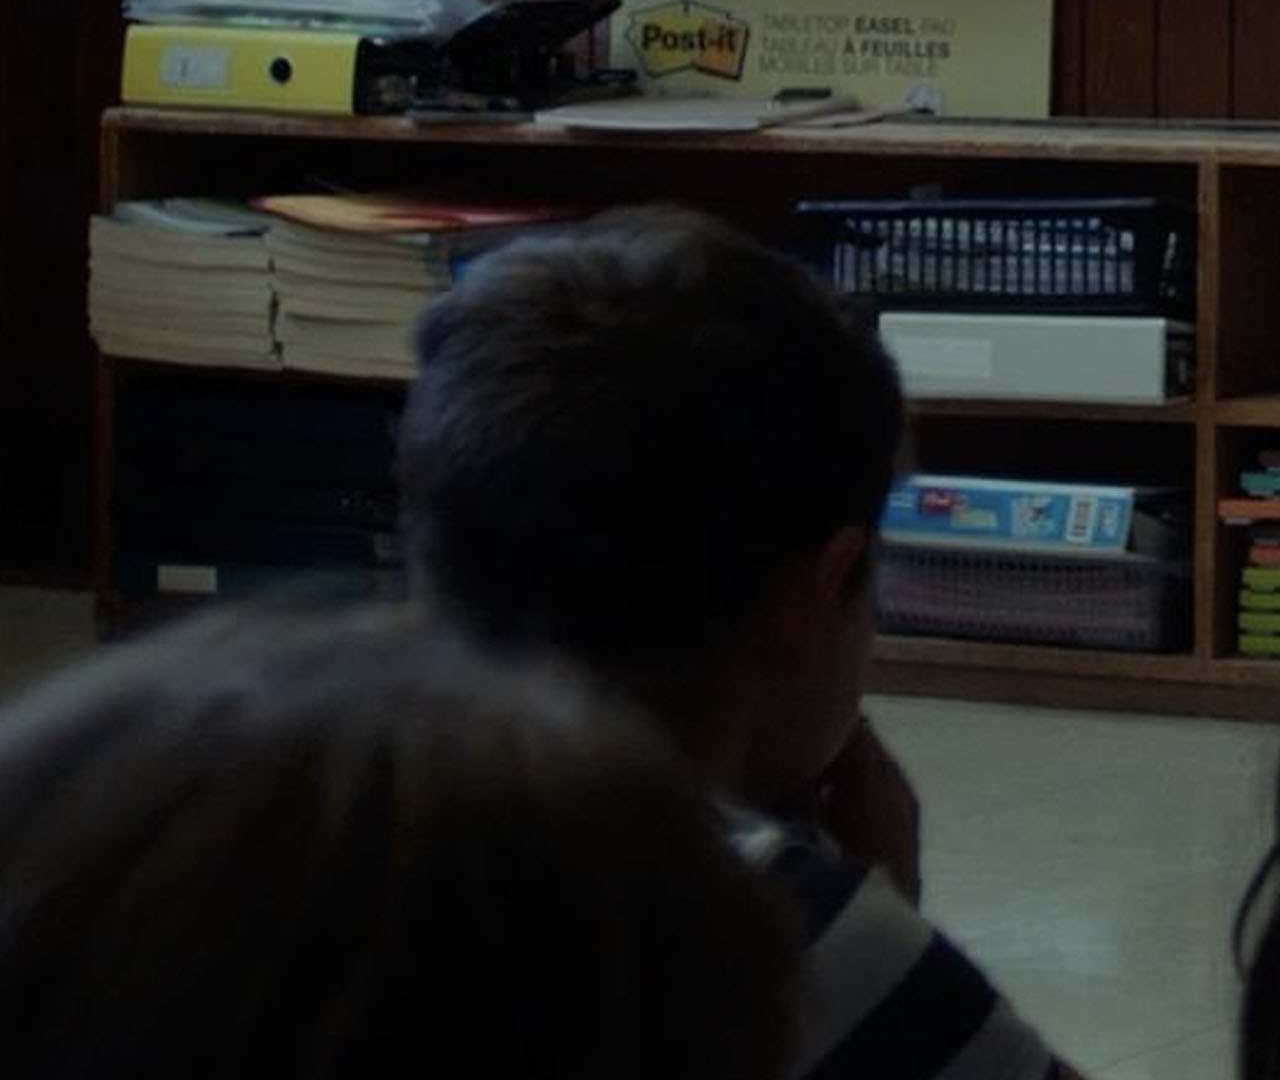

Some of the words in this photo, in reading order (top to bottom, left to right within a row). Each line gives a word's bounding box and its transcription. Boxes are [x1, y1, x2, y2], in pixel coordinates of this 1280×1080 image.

[854, 17, 915, 36] EASEL
[641, 24, 737, 53] Post-it
[860, 38, 951, 58] FEUILLES
